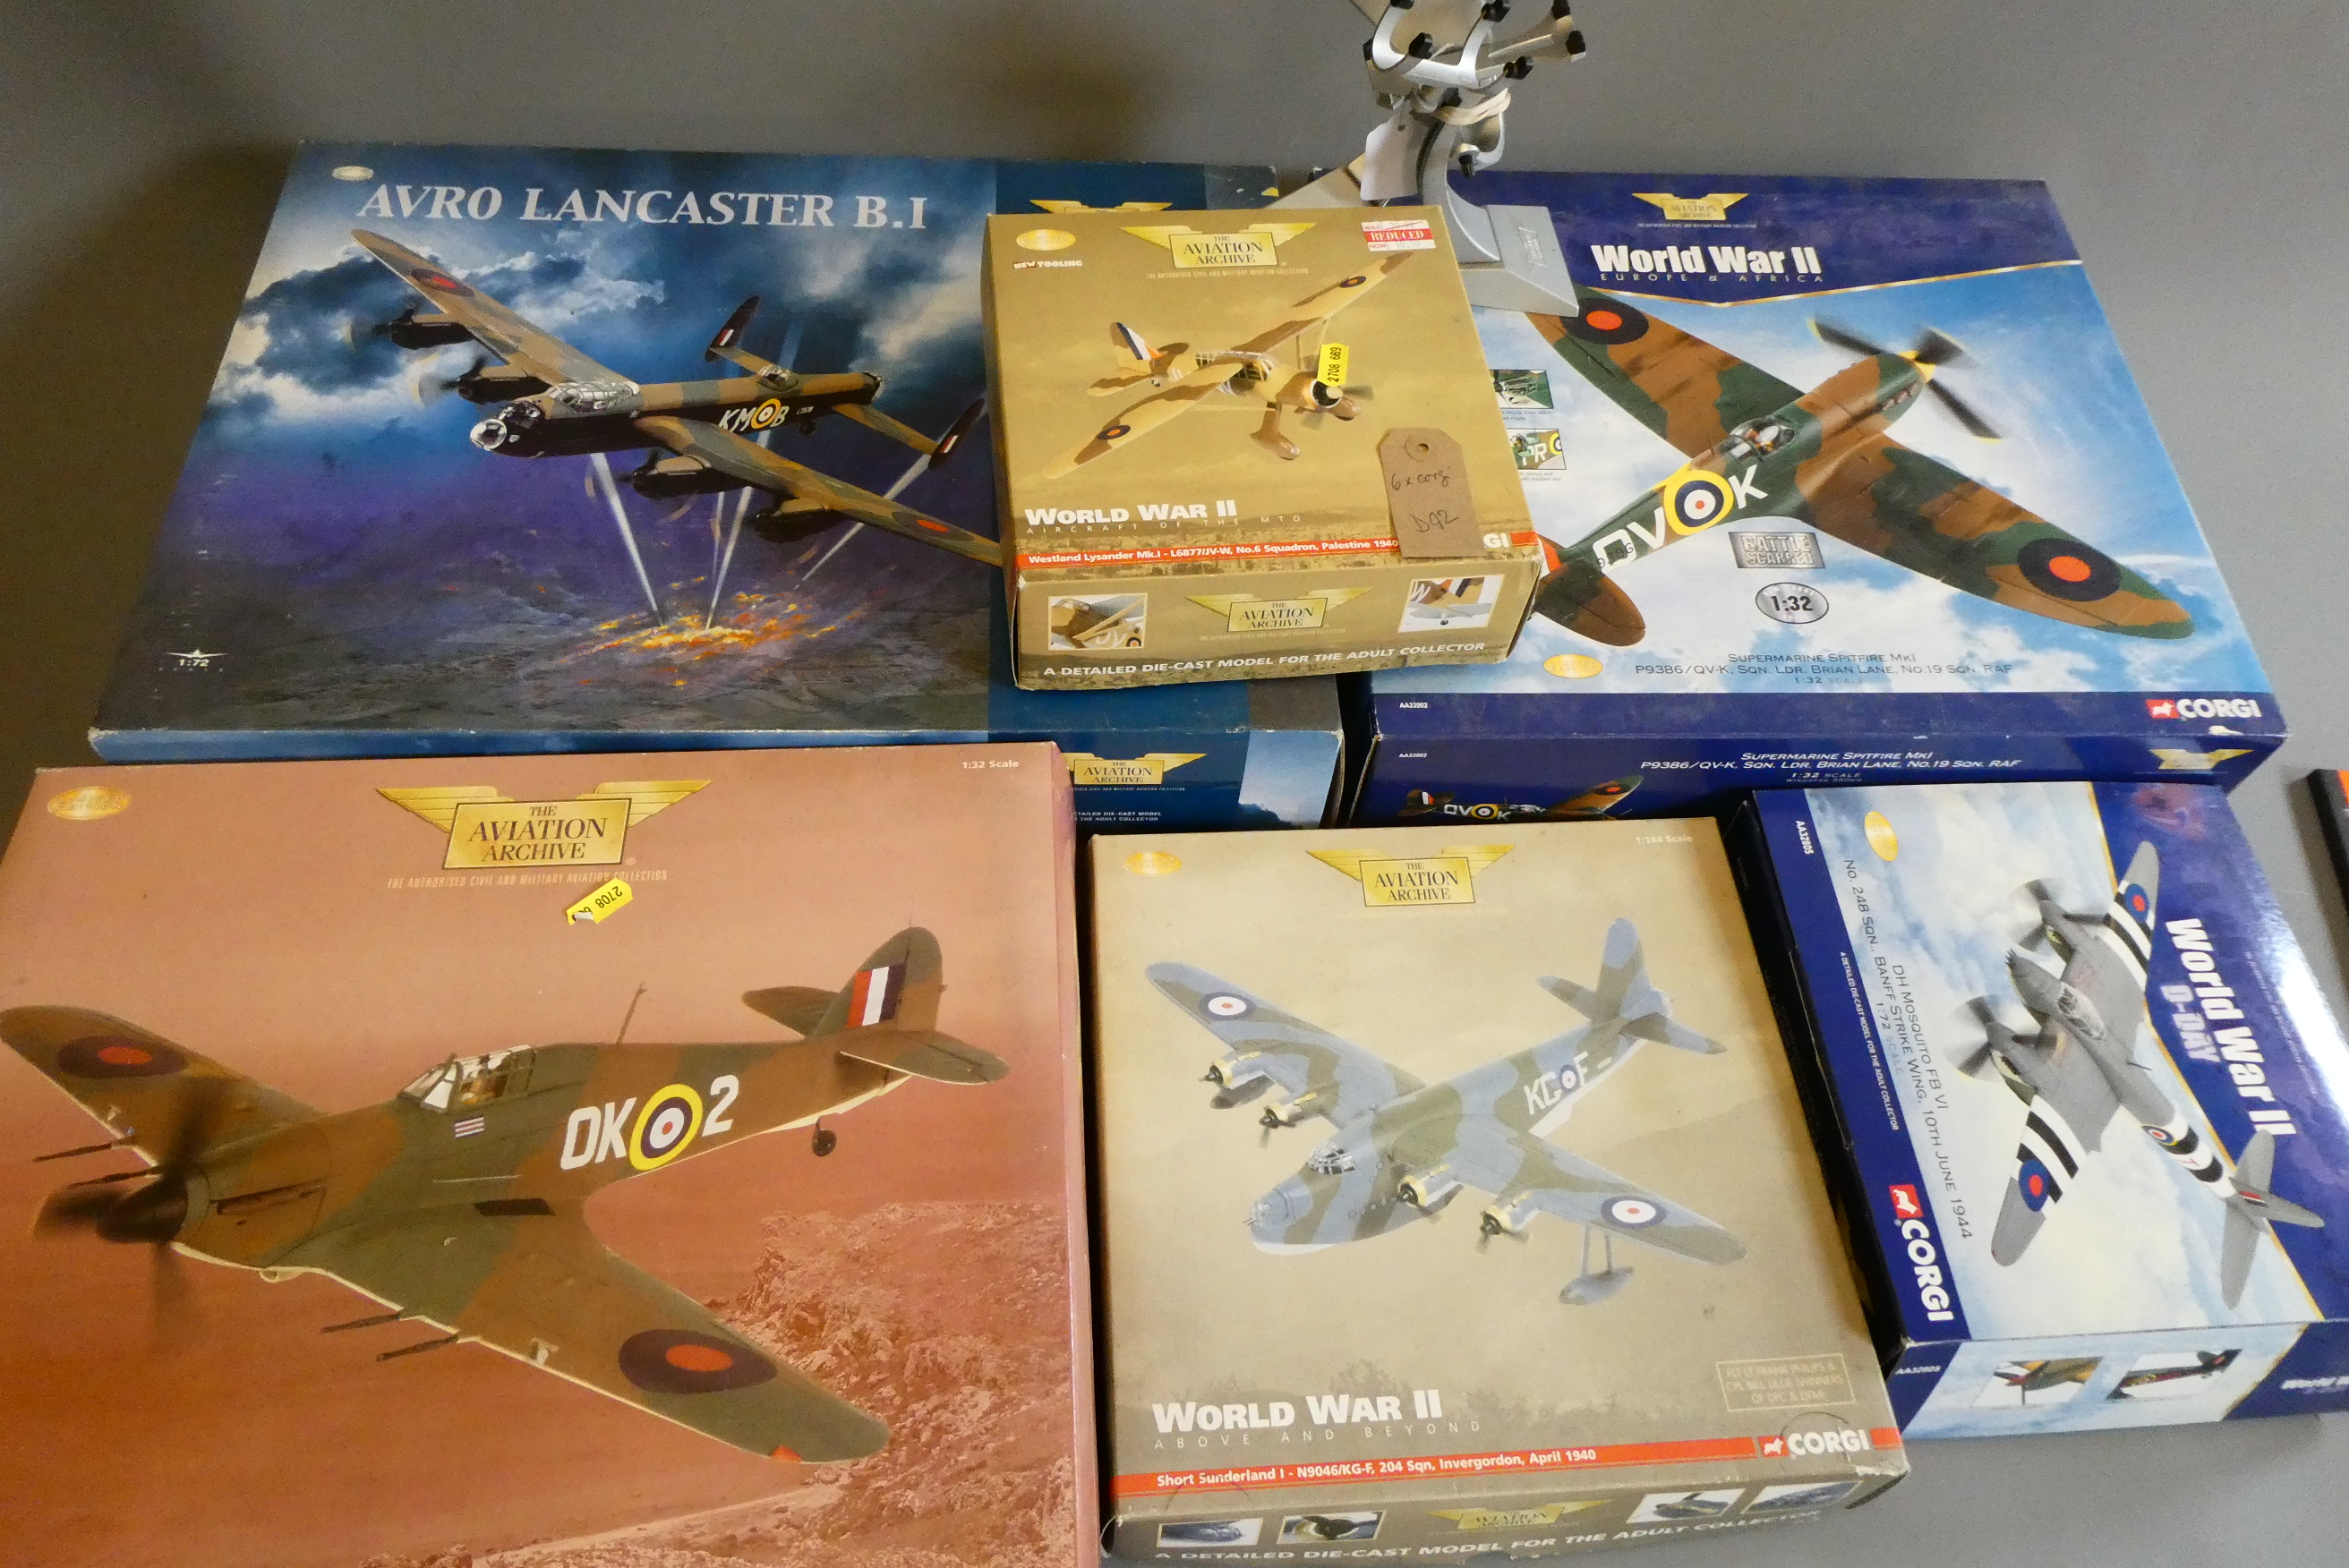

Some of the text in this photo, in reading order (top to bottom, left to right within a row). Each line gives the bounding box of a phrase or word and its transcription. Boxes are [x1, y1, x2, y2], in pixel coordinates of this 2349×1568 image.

[358, 184, 927, 229] AVRO LANCASTER B.I
[1371, 230, 1424, 241] REDUCED
[1183, 242, 1263, 254] AVIATION
[1196, 254, 1255, 265] ARCHIVE
[1591, 245, 1823, 274] World War II
[1601, 273, 1687, 282] EUROPE
[1739, 275, 1823, 283] AFRICA
[1327, 347, 1341, 382] 2708 669
[719, 406, 790, 431] KM B
[1391, 473, 1401, 490] 6
[1728, 464, 1768, 509] K
[1025, 499, 1237, 525] WORLD WAR II
[1027, 518, 1239, 534] AIRCRAFT OF THE
[1029, 553, 1081, 564] Westland
[1084, 551, 1133, 562] Lysander
[1236, 544, 1261, 554] No.6
[1264, 543, 1319, 553] Squadron,
[1322, 540, 1370, 550] Palestine
[1374, 539, 1399, 547] 1940
[1741, 535, 1811, 551] BATTLE
[1746, 550, 1814, 565] SCARRED
[1771, 595, 1814, 611] 1:32
[1239, 607, 1314, 620] AVIATION
[1248, 618, 1303, 628] ARCHIVE
[179, 659, 209, 667] 1:72
[1061, 665, 1136, 676] DETAILED
[1142, 660, 1211, 672] DIE-CAST
[1218, 657, 1273, 667] MODEL
[1279, 655, 1309, 664] FOR
[1314, 653, 1341, 661] THE
[1346, 649, 1395, 660] ADULT
[1400, 643, 1485, 655] COLLECTOR
[1728, 653, 1887, 662] SUPERMARINE SPITFIRE
[1811, 665, 1853, 674] BRIAN
[1984, 664, 2012, 673] RAF
[2176, 698, 2262, 718] CORGI
[962, 760, 1019, 769] 1:32 Scale
[1816, 761, 1859, 769] BRIAN
[1988, 760, 2022, 768] RAF
[1842, 752, 1901, 760] SPITFIRE
[1083, 766, 1153, 777] AVIATION
[1093, 776, 1144, 784] ARCHIVE
[529, 805, 558, 817] THE
[467, 817, 610, 842] AVIATION
[482, 841, 586, 862] ARCHIVE
[1405, 862, 1423, 870] THE
[388, 878, 405, 889] THE
[407, 877, 466, 888] AUTHORISED
[470, 875, 493, 886] CIVIL
[497, 875, 517, 886] AND
[519, 873, 564, 885] MILITARY
[567, 872, 611, 883] AVIATION
[1375, 871, 1458, 888] AVIATION
[594, 885, 624, 909] 2708
[1388, 888, 1451, 902] ARCHIVE
[1841, 957, 1857, 987] DETAILED
[1876, 1002, 1891, 1030] 1:72
[2165, 918, 2244, 1019] World
[2214, 1027, 2276, 1102] War
[2160, 984, 2221, 1062] D-DAY
[1892, 965, 1949, 1110] DH MOSQUITO FB VI
[1574, 1051, 1588, 1087] F
[1852, 886, 1869, 913] 248
[1874, 957, 1896, 1001] BANFF
[1890, 1005, 1913, 1054] STRIKE
[1923, 1110, 1941, 1146] 10TH
[1935, 1151, 1956, 1191] JUNE
[1951, 1198, 1973, 1239] 1944
[702, 1074, 739, 1137] 2
[1901, 1219, 1954, 1322] CORGI
[1152, 1389, 1442, 1433] WORLD WAR II
[1155, 1421, 1480, 1450] ABOVE AND BEYOND
[1788, 1428, 1869, 1456] CORGI
[1157, 1449, 1596, 1487] Short Sunderland N9046/KG-F, 204 Sqn, Invergordon, April 1940
[1181, 1551, 1295, 1560] DETAILED
[1303, 1547, 1412, 1559] DIE-CAST
[1419, 1542, 1503, 1555] MODEL
[1511, 1538, 1557, 1549] FOR
[1566, 1533, 1607, 1544] THE
[1612, 1526, 1688, 1539] ADULT
